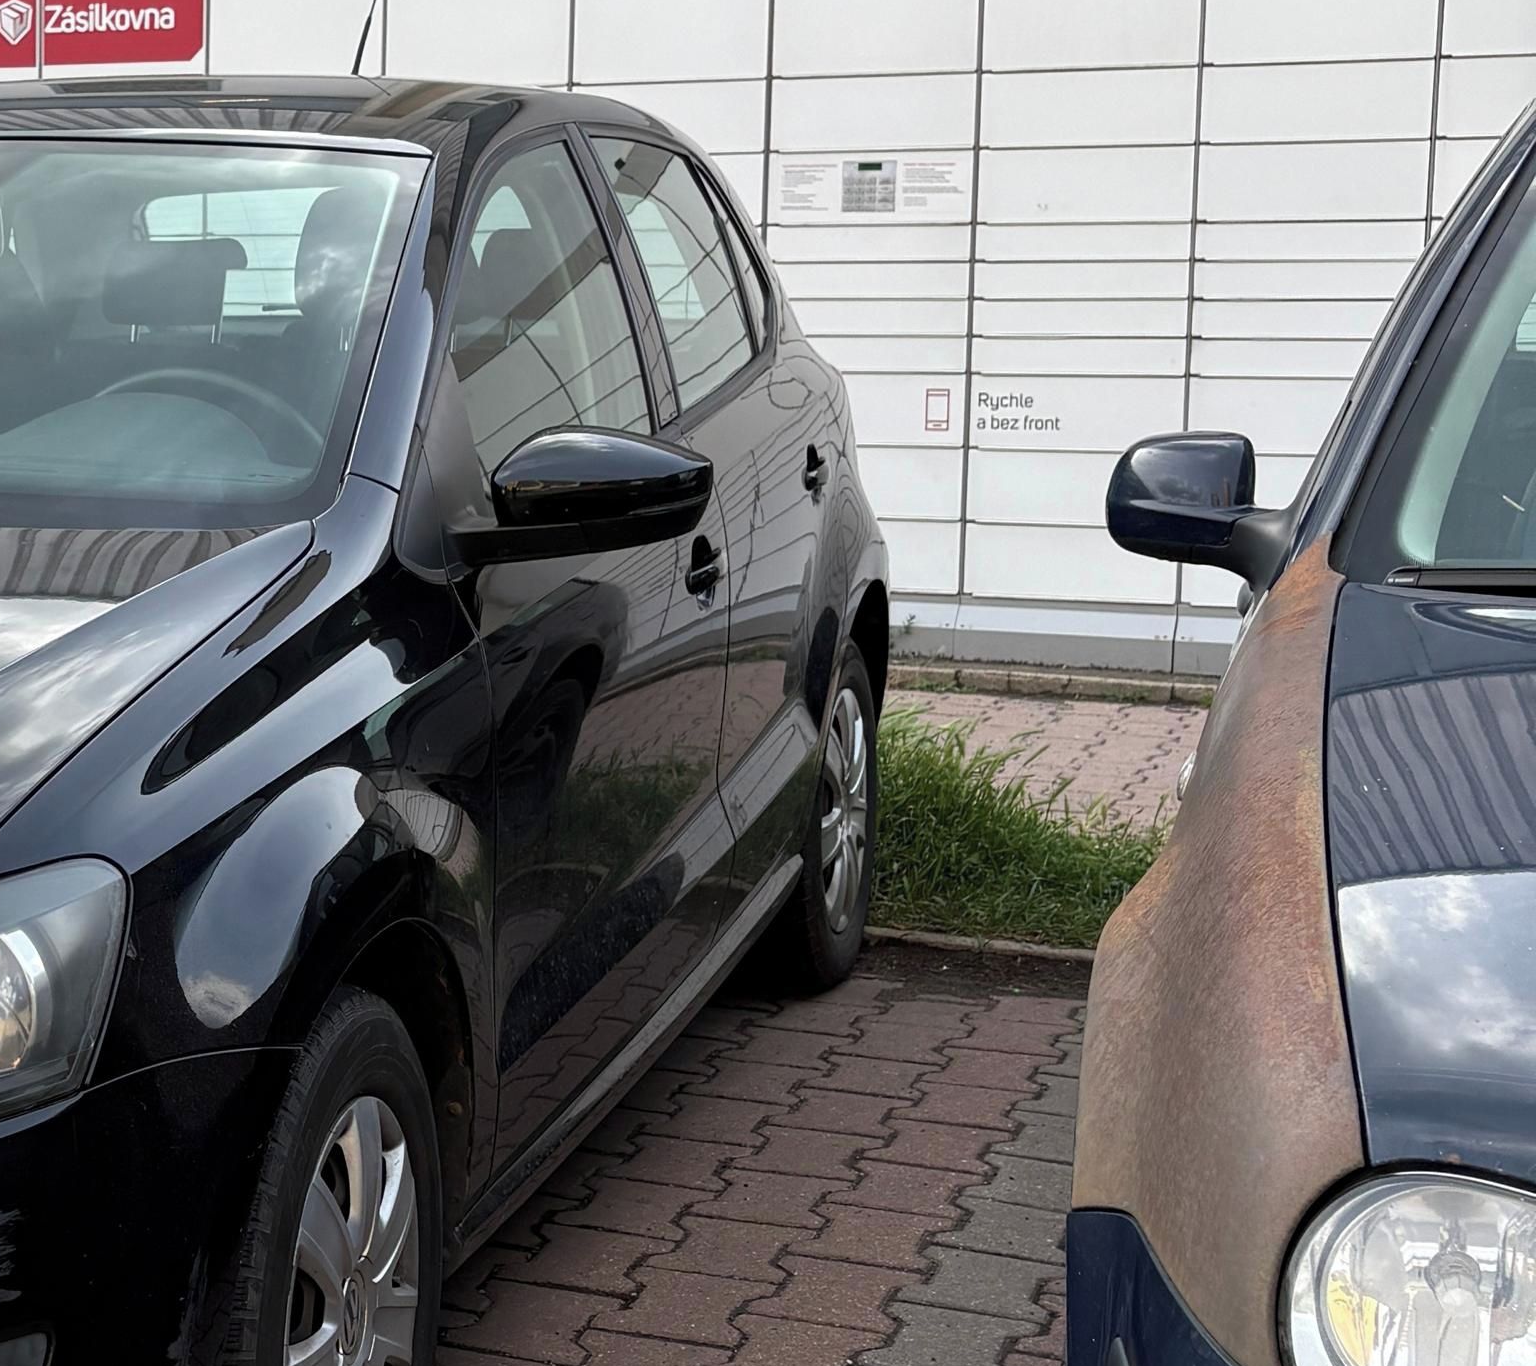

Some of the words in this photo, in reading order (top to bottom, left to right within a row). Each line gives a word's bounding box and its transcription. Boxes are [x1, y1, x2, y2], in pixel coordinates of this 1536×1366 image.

[44, 3, 176, 34] Zásilkovna
[977, 392, 1034, 411] Rychle
[976, 418, 987, 430] a
[990, 415, 1020, 431] bez
[1023, 415, 1061, 431] front
